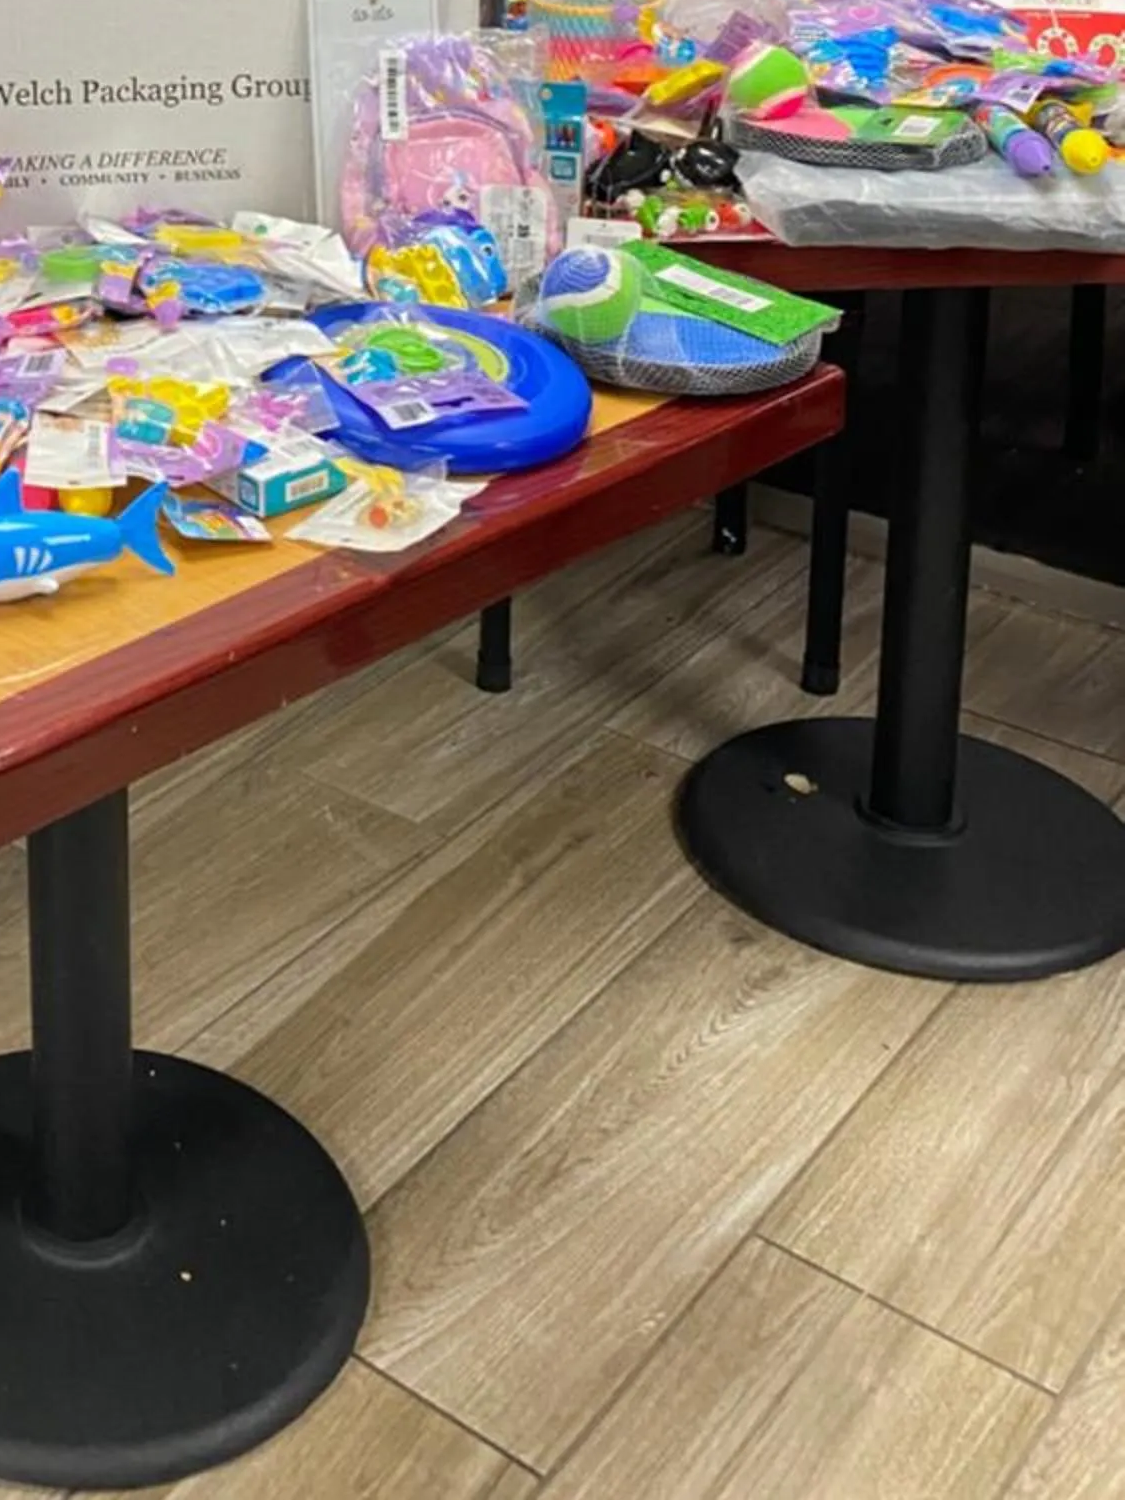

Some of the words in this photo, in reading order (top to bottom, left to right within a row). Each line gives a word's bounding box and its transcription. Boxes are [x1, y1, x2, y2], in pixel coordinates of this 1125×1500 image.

[80, 75, 224, 110] Packaging
[78, 153, 94, 171] A
[96, 147, 229, 170] DIFFERENCE
[58, 171, 150, 188] COMMUNITY
[173, 167, 243, 184] BUSINESS
